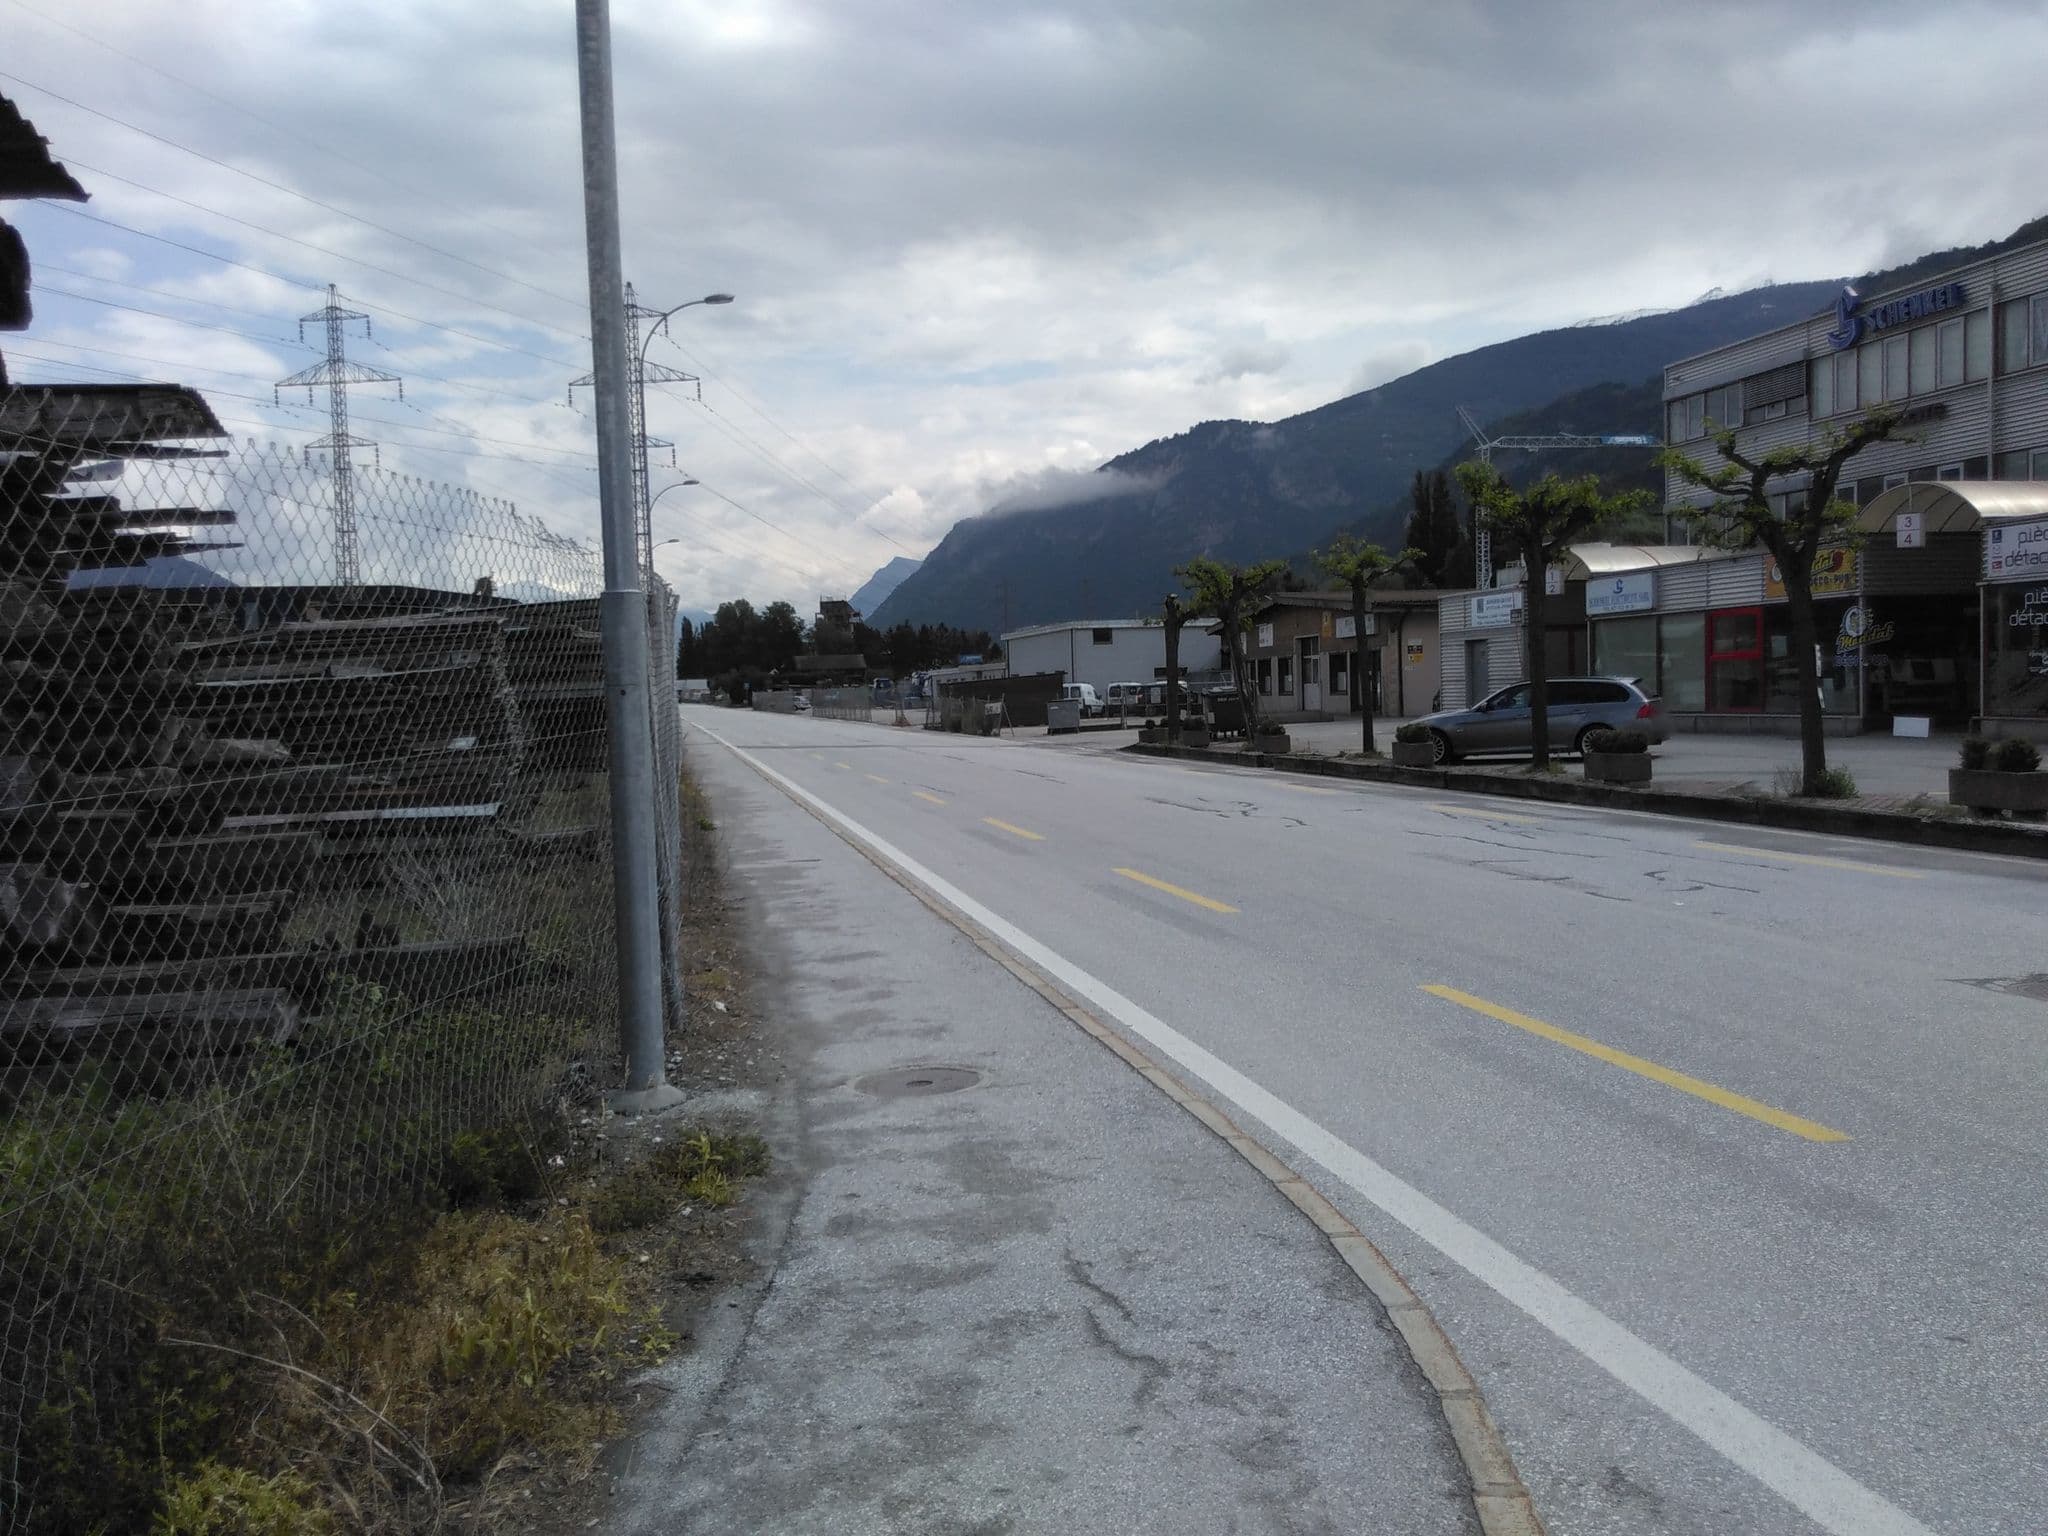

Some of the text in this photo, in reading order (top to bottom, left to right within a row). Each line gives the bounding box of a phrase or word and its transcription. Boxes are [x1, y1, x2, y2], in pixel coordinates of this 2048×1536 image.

[1864, 283, 1962, 332] SCHENKEL
[1904, 516, 1912, 528] 3
[1904, 534, 1912, 545] 4
